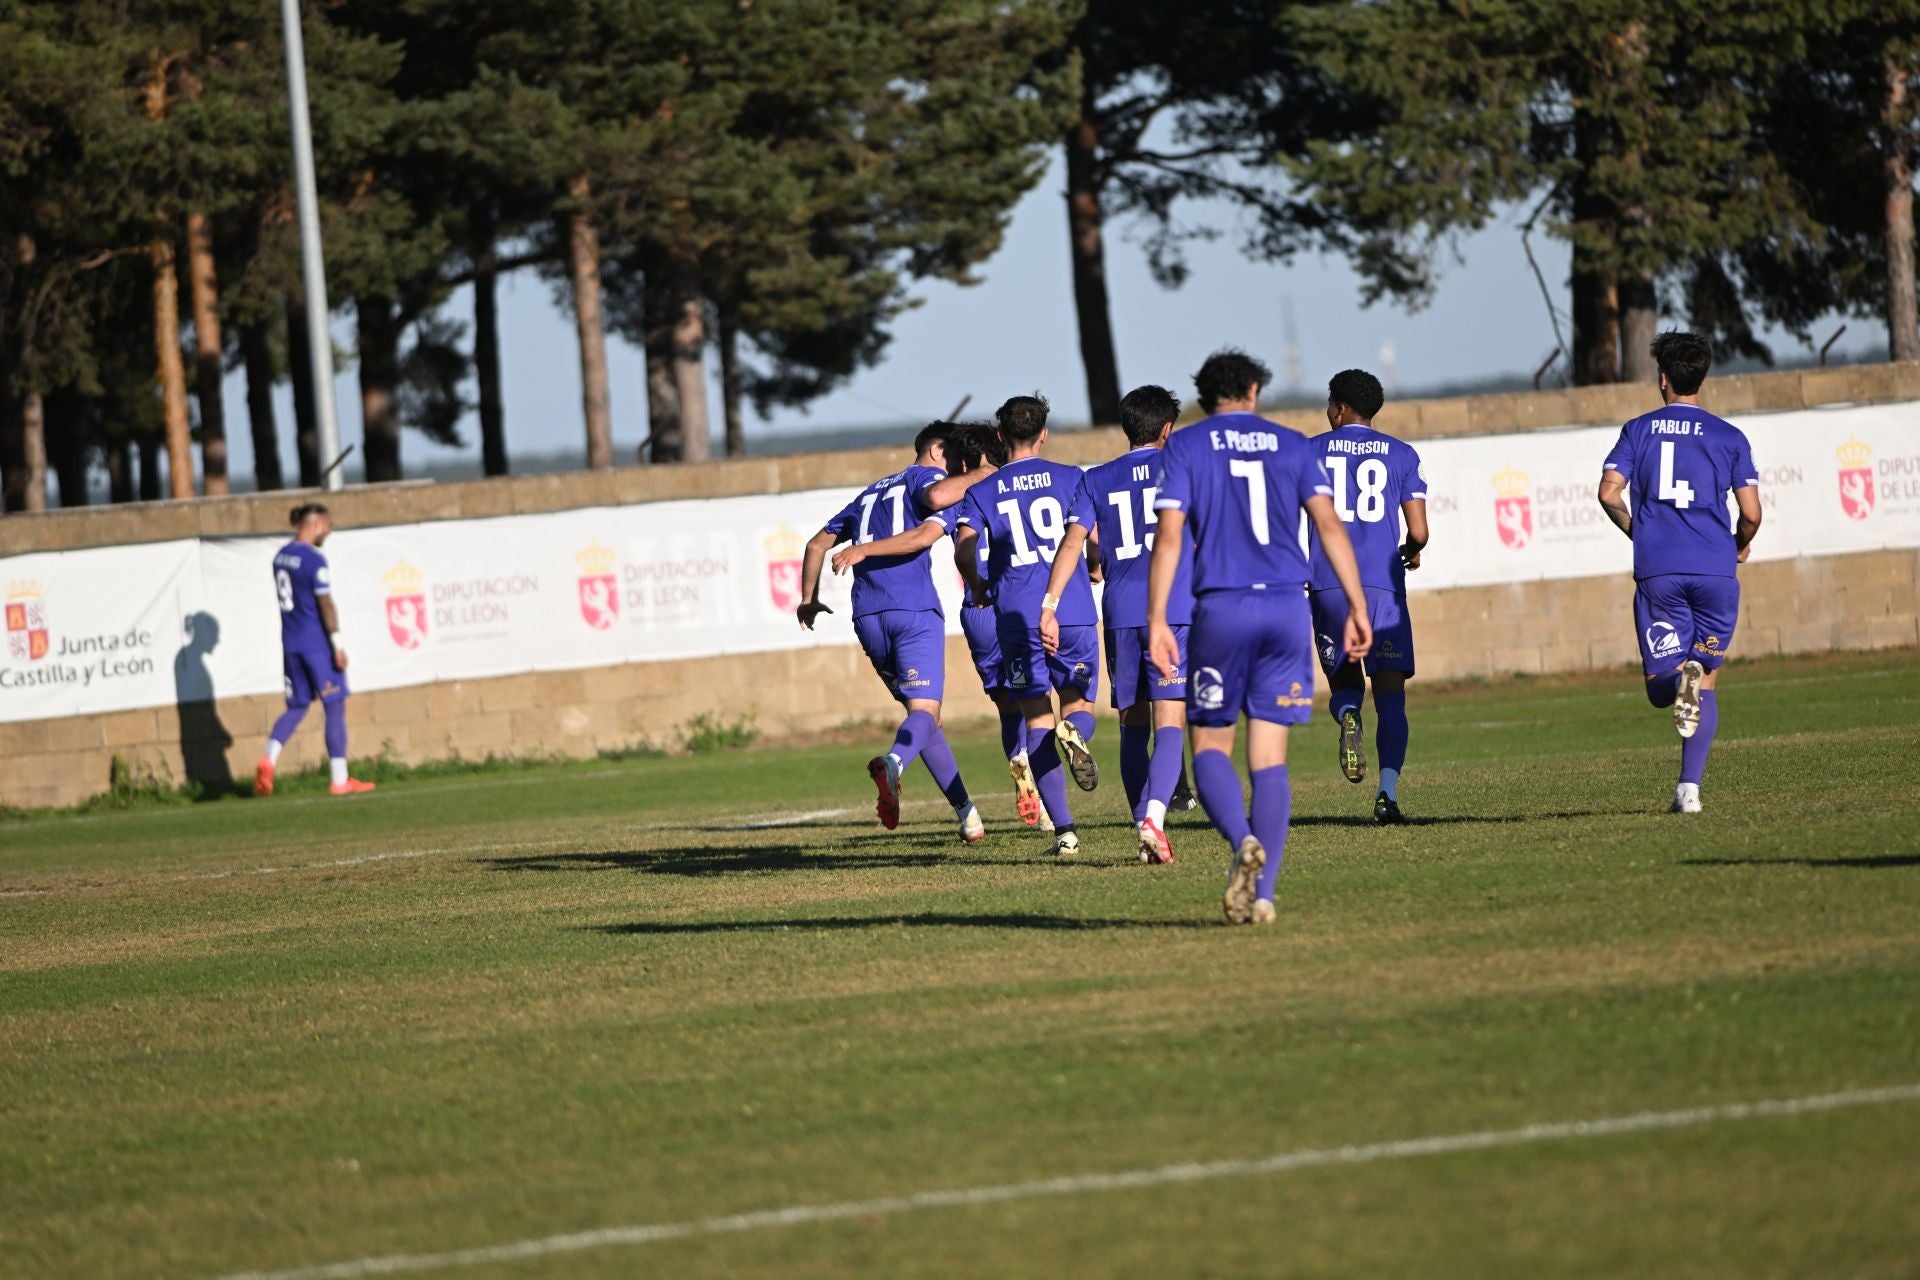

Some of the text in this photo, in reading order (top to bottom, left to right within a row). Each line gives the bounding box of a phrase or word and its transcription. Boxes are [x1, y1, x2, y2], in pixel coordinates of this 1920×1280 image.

[1651, 419, 1704, 436] PABLO F.
[1209, 430, 1226, 451] F.
[1327, 439, 1389, 455] ANDERSON
[997, 472, 1052, 494] A. ACERO
[1132, 464, 1150, 482] IVI
[1658, 441, 1695, 508] 4
[1325, 456, 1388, 523] 18
[1880, 479, 1920, 500] DE LE
[1229, 459, 1270, 545] 7
[1538, 509, 1559, 530] DE
[996, 496, 1067, 567] 19
[436, 607, 457, 627] DE
[58, 627, 151, 656] Junta de
[1652, 647, 1684, 660] TACO BELL
[0, 655, 154, 688] Castilla y León
